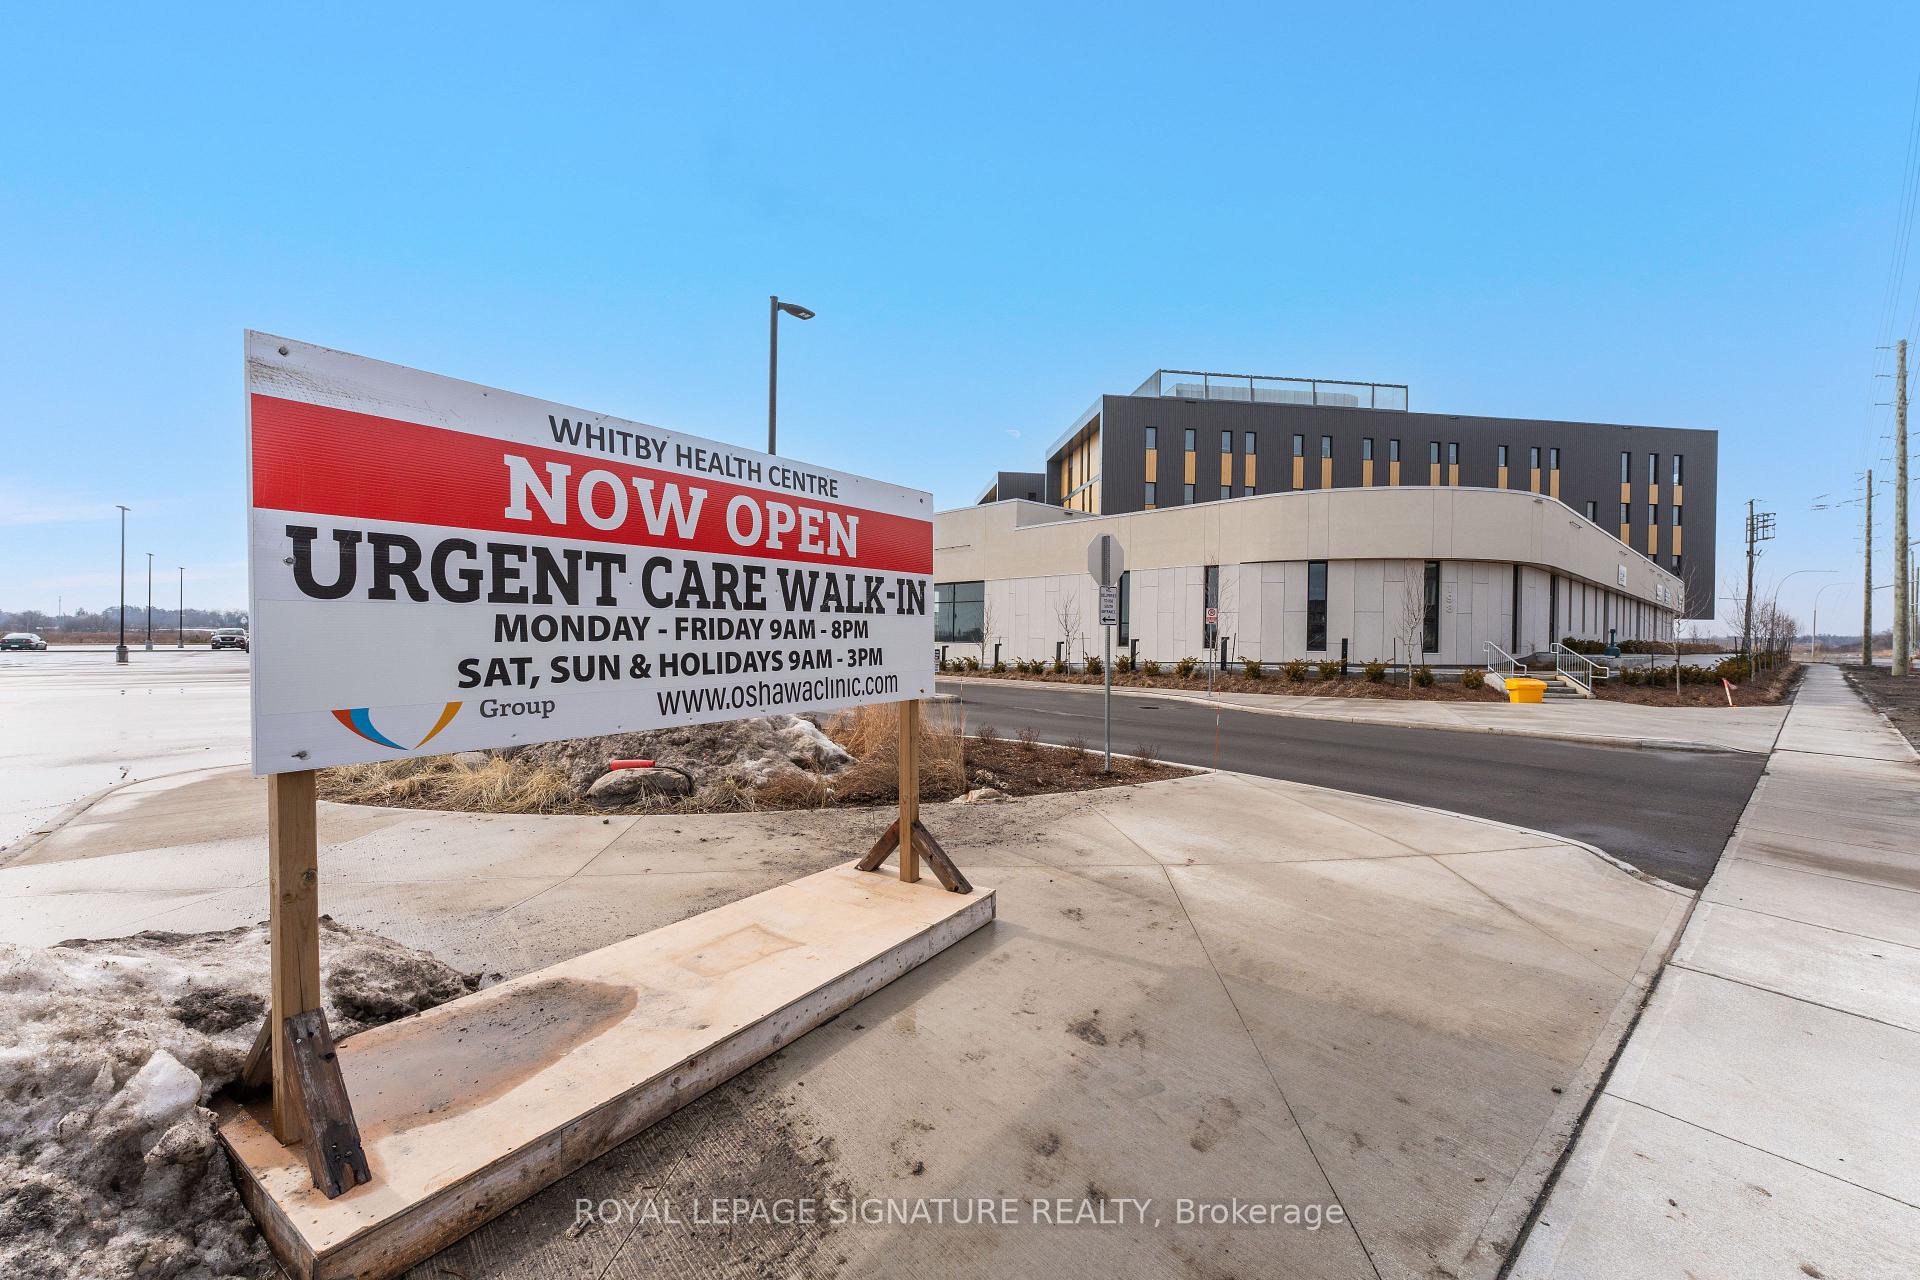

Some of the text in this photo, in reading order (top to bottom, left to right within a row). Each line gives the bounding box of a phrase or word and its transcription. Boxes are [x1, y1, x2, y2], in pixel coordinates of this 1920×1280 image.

[548, 415, 838, 499] WHITBY HEALTH CENTRE
[504, 454, 858, 559] NOW OPEN
[286, 524, 927, 616] URGENT CARE WALK-IN
[494, 614, 651, 642] MONDAY
[675, 616, 764, 641] FRIDAY
[769, 619, 816, 640] 9AM
[831, 620, 869, 639] 8PM
[458, 657, 540, 689] SAT,
[551, 654, 621, 683] SUN
[629, 653, 651, 679] &
[659, 650, 783, 677] HOLIDAYS
[789, 648, 833, 671] 9AM
[847, 647, 883, 668] 3PM
[479, 698, 556, 719] Group
[657, 673, 899, 716] www.oshawaclinic.com
